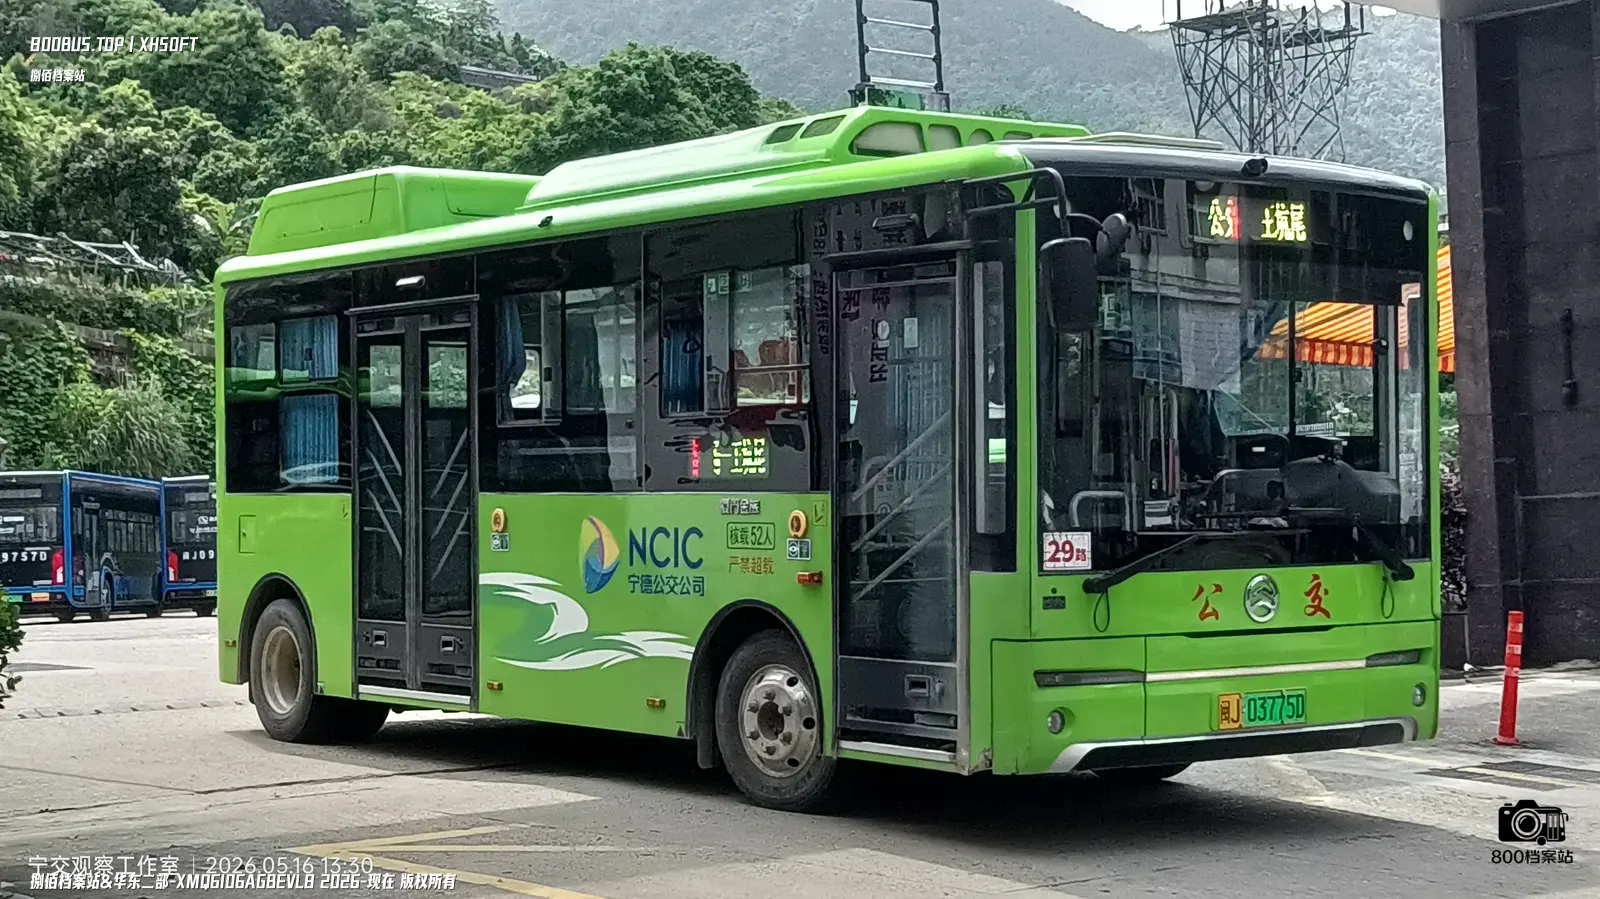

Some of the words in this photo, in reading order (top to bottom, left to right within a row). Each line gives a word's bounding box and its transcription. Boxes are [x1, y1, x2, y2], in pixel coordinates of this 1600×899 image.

[729, 525, 773, 546] 核载52人
[628, 526, 703, 570] NCIC
[728, 556, 774, 575] 严禁超载
[628, 573, 705, 596] 宁德公交公司
[1191, 583, 1223, 622] 公
[1303, 573, 1331, 619] 交
